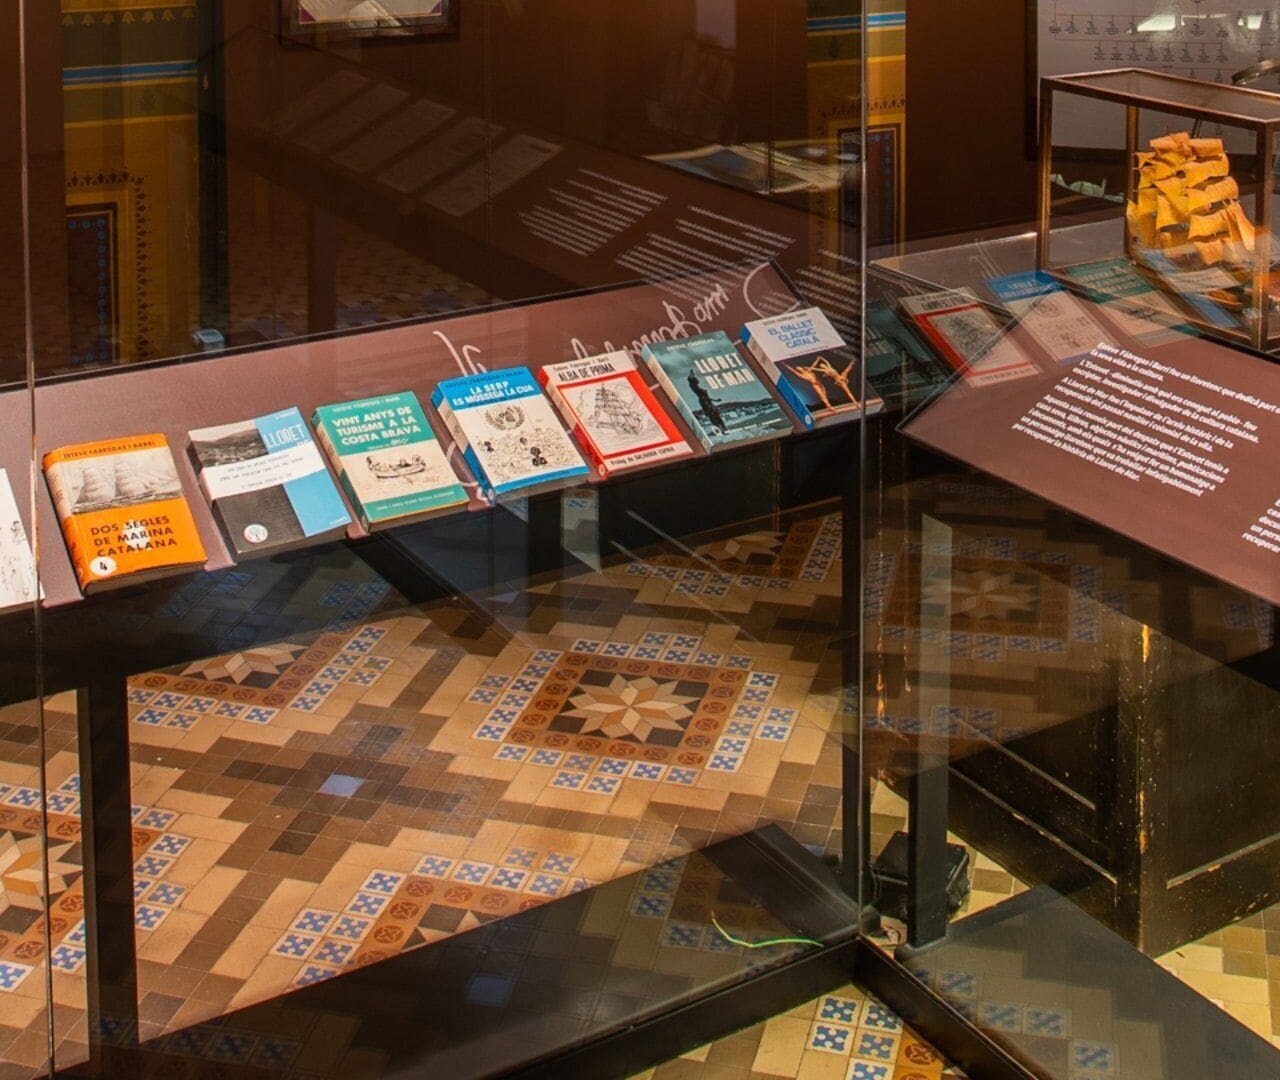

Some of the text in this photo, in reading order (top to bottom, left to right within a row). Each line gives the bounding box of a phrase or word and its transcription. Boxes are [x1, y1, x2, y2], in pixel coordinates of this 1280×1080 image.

[768, 319, 813, 336] EL BALLET
[558, 362, 617, 383] ALBA DE PRIMA
[694, 352, 744, 374] LLORET
[470, 381, 509, 395] LA SERP
[705, 368, 756, 390] DE MAR
[452, 397, 464, 406] ES
[506, 388, 517, 397] LA
[517, 384, 535, 394] CUA
[332, 406, 412, 428] VINT ANYS DE
[336, 416, 417, 437] TURISME A LA
[341, 432, 380, 446] COSTA
[381, 426, 422, 439] BRAVA
[90, 515, 170, 536] DOS SEGLES
[93, 527, 174, 547] DE MARINA
[97, 539, 178, 558] CATALANA
